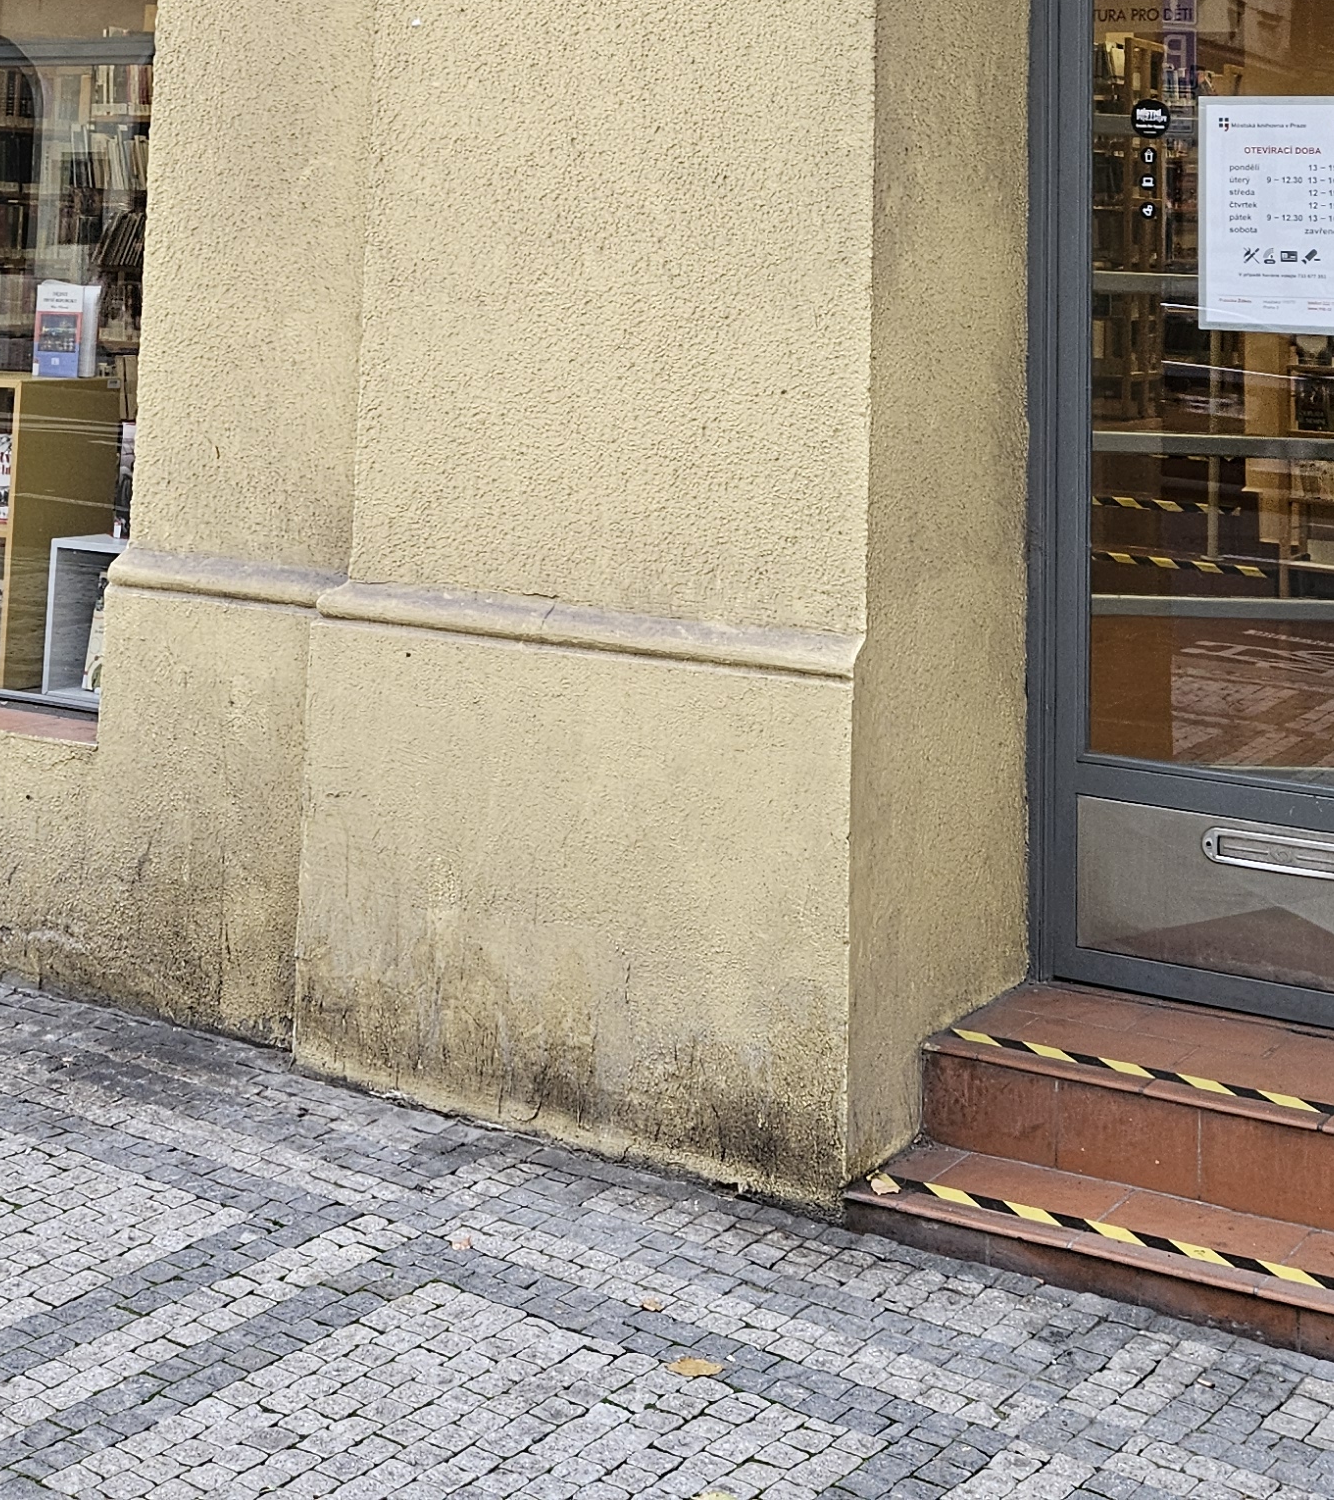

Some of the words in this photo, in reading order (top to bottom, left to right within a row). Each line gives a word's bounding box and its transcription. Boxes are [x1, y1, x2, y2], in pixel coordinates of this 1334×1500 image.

[1131, 8, 1159, 21] PRO
[1244, 145, 1292, 154] OTEVÍRACÍ
[1295, 147, 1322, 155] DOBA
[1229, 164, 1260, 172] pondělí
[1308, 164, 1318, 172] 13
[1229, 176, 1250, 185] úterý
[1266, 176, 1272, 184] 9
[1282, 176, 1303, 184] 12.30
[1308, 176, 1318, 184] 13
[1308, 189, 1318, 197] 12
[1229, 214, 1252, 222] pátek
[1282, 214, 1303, 222] 12.30
[1308, 214, 1318, 222] 13
